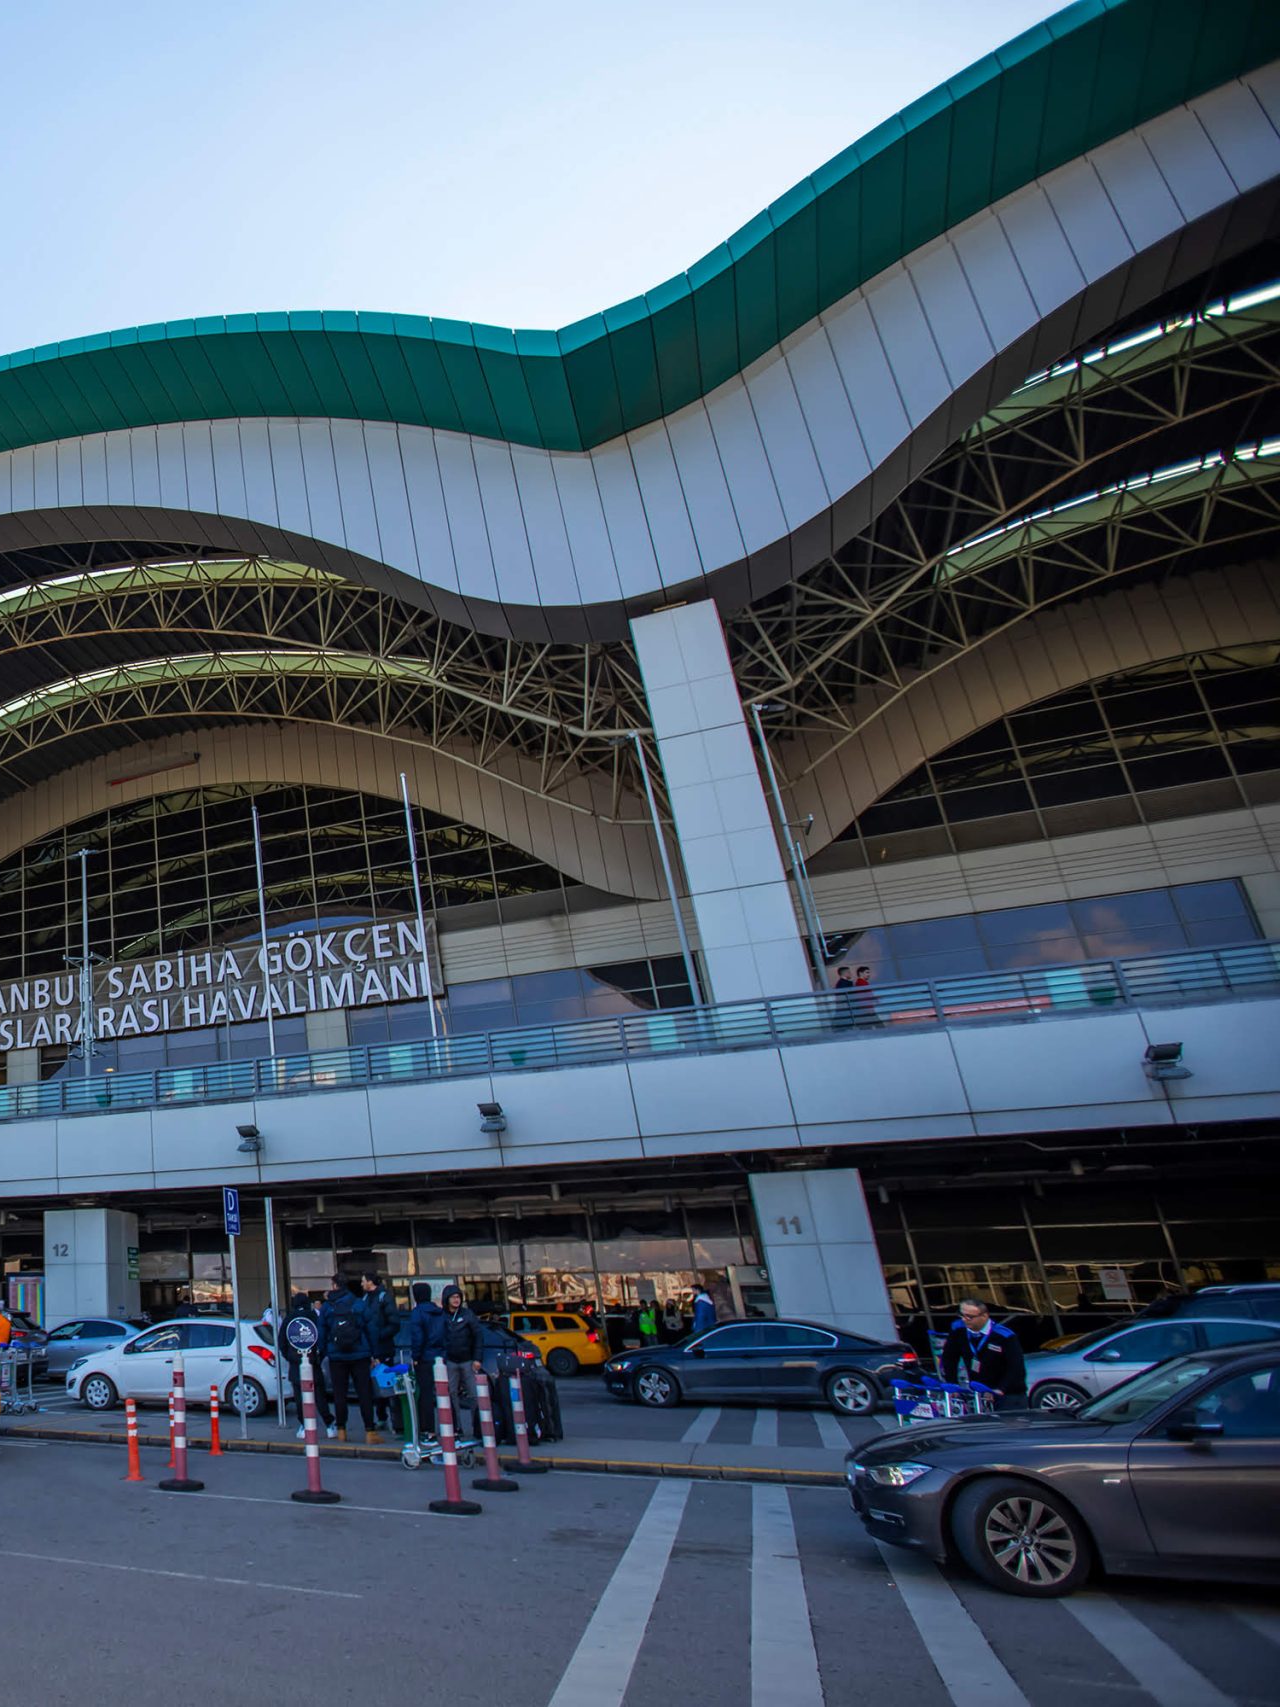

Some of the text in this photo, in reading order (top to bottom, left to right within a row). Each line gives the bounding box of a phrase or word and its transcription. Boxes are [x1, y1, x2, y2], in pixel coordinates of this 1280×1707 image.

[108, 950, 242, 999] SABİHA
[258, 919, 423, 975] GÖKÇEN
[184, 961, 428, 1027] HAVALİMANI
[227, 1191, 235, 1211] D
[776, 1216, 802, 1234] 11
[52, 1243, 69, 1257] 12
